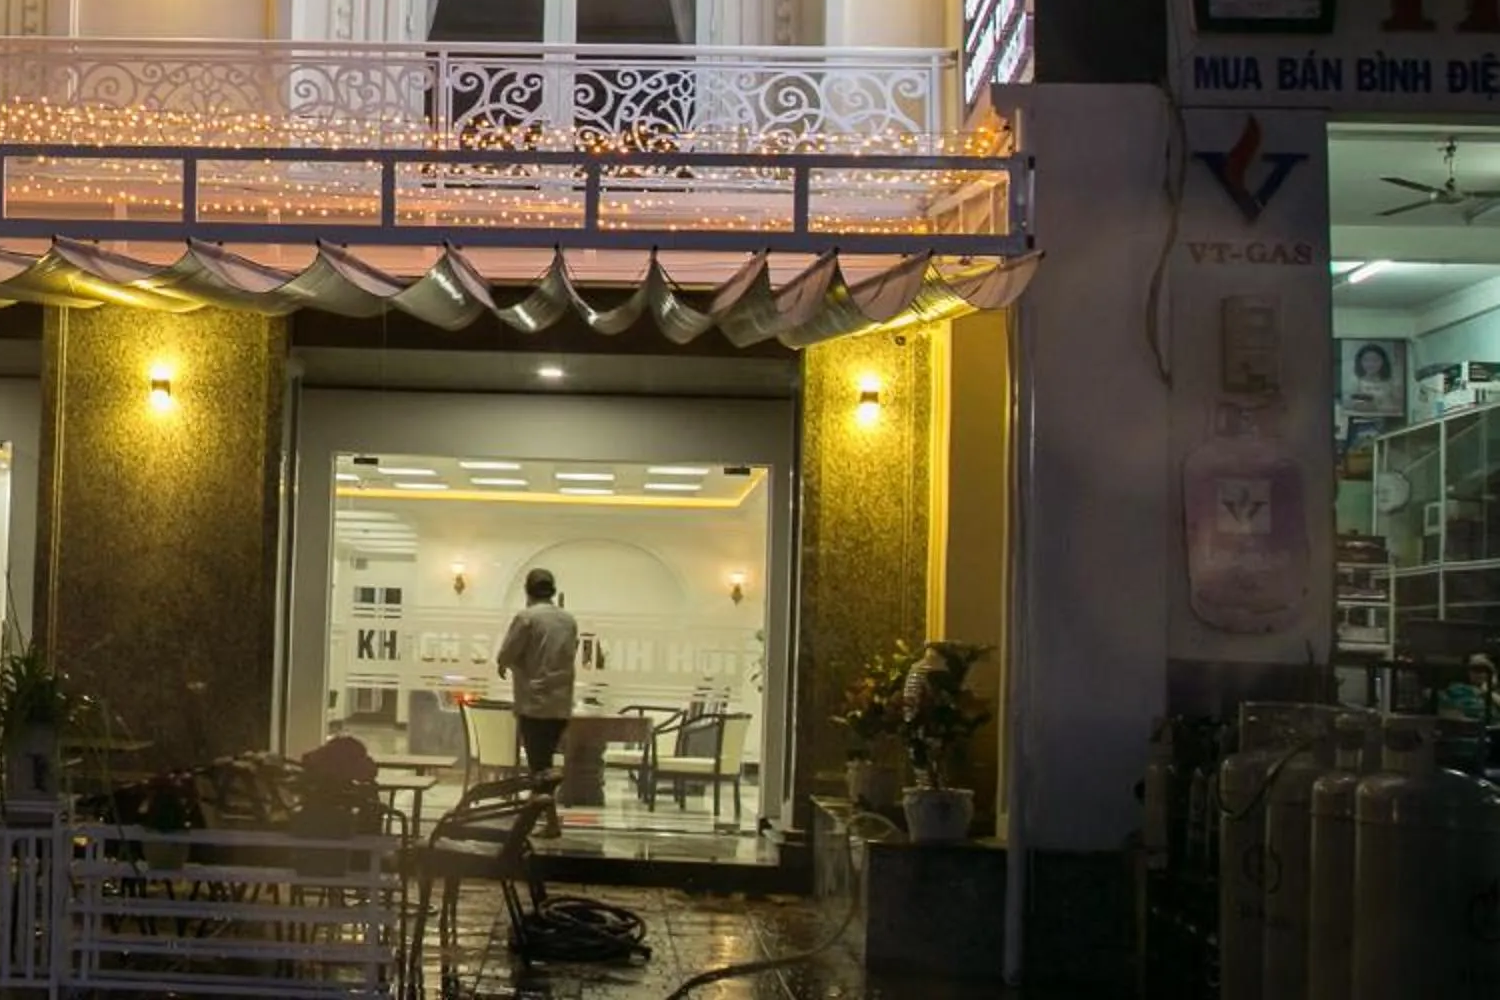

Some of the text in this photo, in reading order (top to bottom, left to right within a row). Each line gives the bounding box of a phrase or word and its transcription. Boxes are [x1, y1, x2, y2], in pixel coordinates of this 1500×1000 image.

[1194, 56, 1263, 91] MUA
[1278, 50, 1342, 92] BÁN
[1357, 49, 1432, 93] BÌNH
[1186, 240, 1313, 265] VT-GAS
